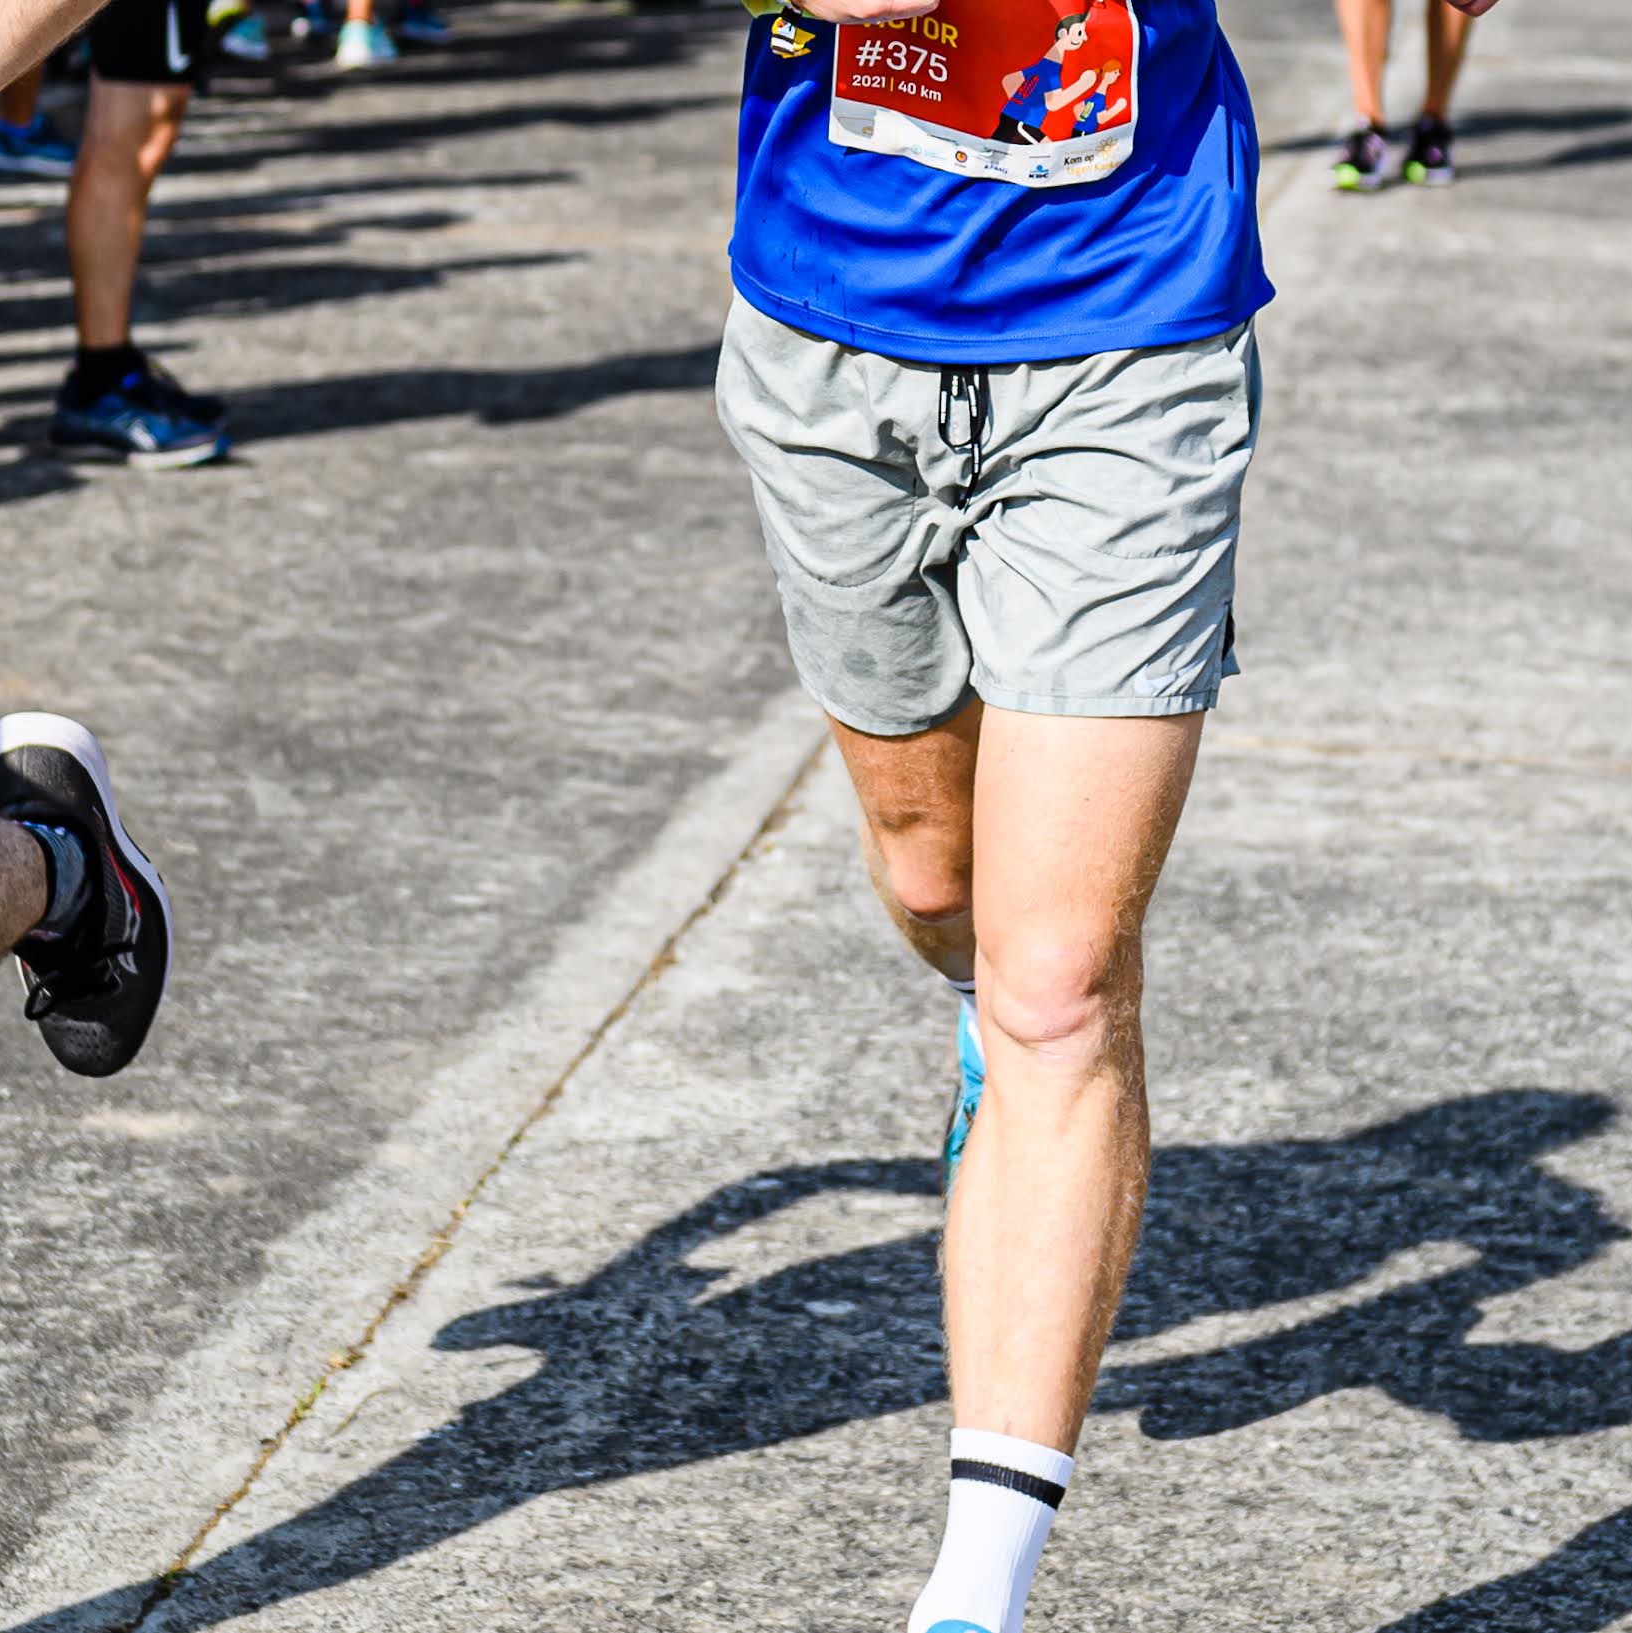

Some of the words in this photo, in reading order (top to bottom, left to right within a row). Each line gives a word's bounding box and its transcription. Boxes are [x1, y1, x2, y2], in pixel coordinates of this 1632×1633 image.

[855, 39, 948, 82] #375
[852, 74, 886, 89] 2021
[898, 80, 916, 95] 40
[920, 85, 942, 102] km
[1064, 156, 1082, 166] Kom
